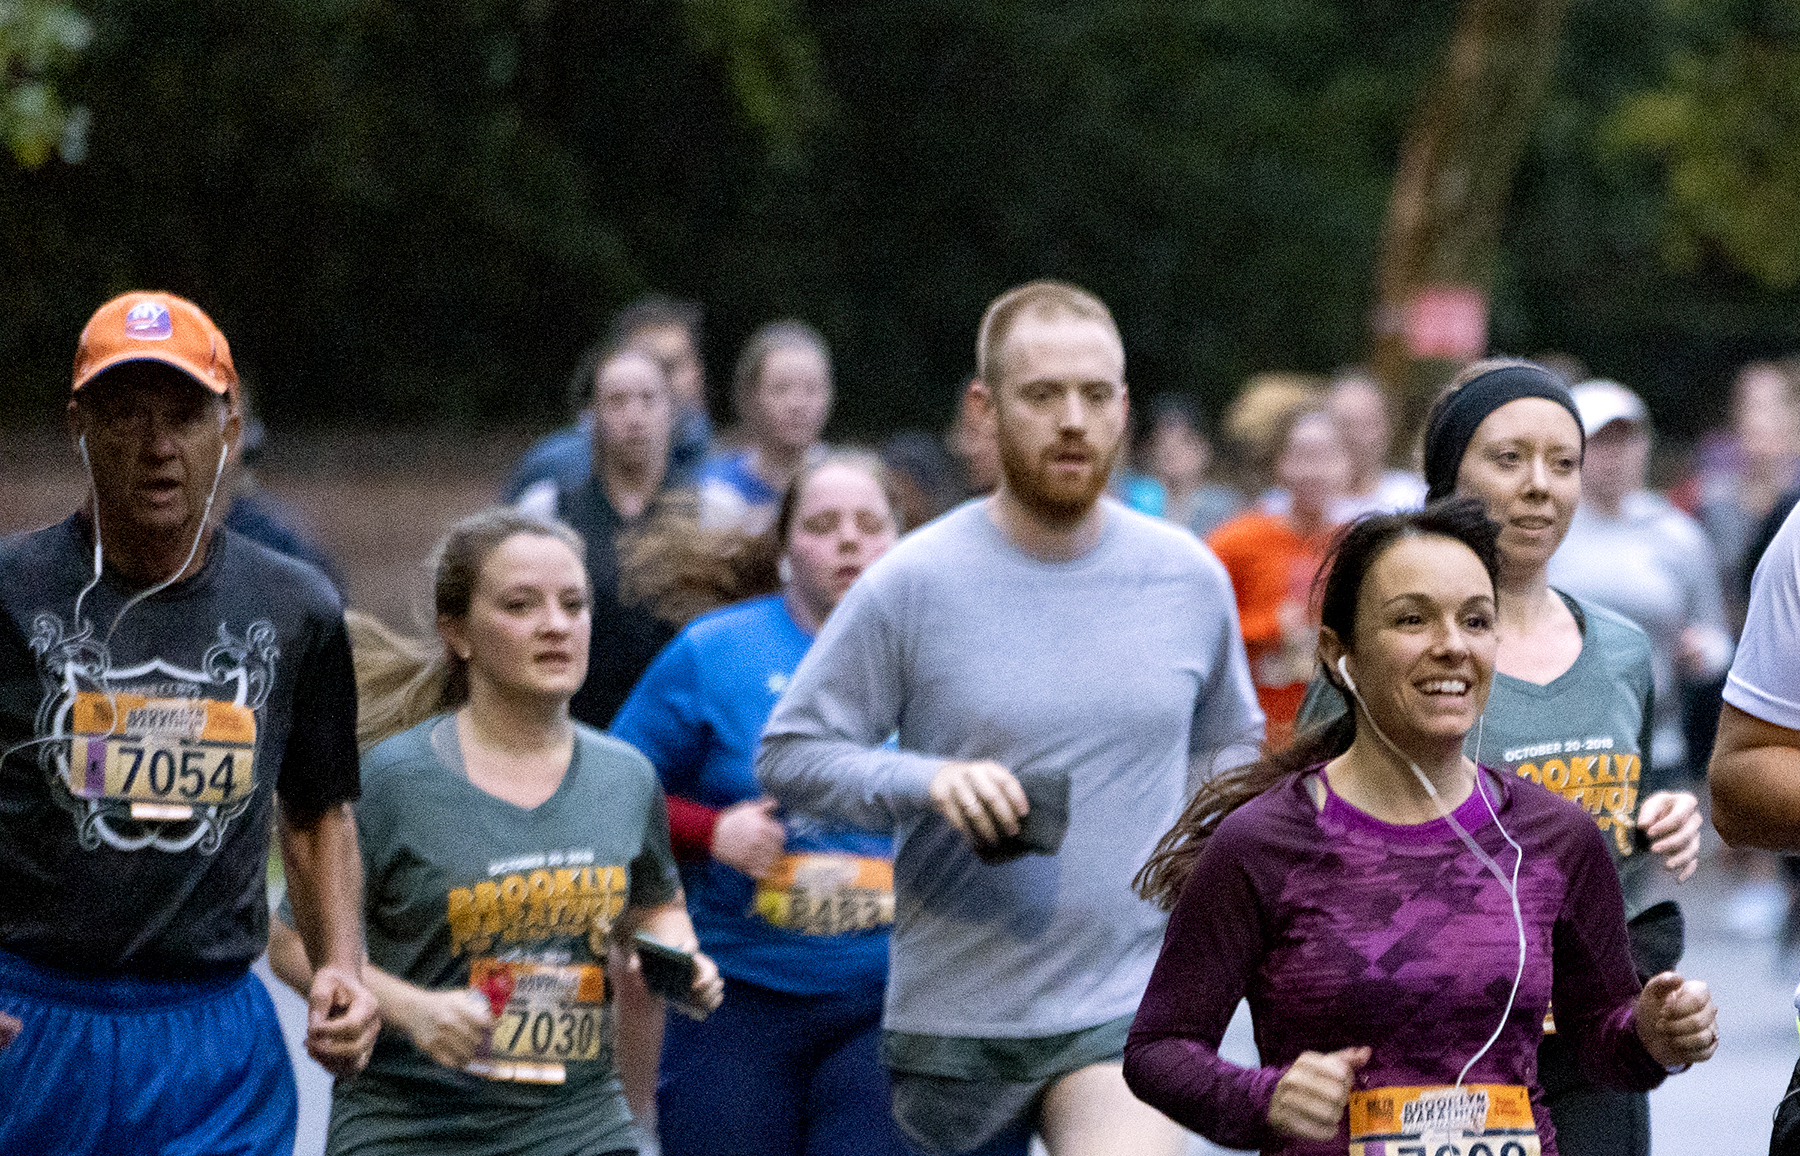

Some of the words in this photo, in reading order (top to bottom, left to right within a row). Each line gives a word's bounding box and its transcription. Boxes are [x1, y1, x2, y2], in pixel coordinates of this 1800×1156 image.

[118, 747, 236, 798] 7054
[1504, 741, 1562, 762] OCTOBER
[506, 1010, 594, 1055] 7030
